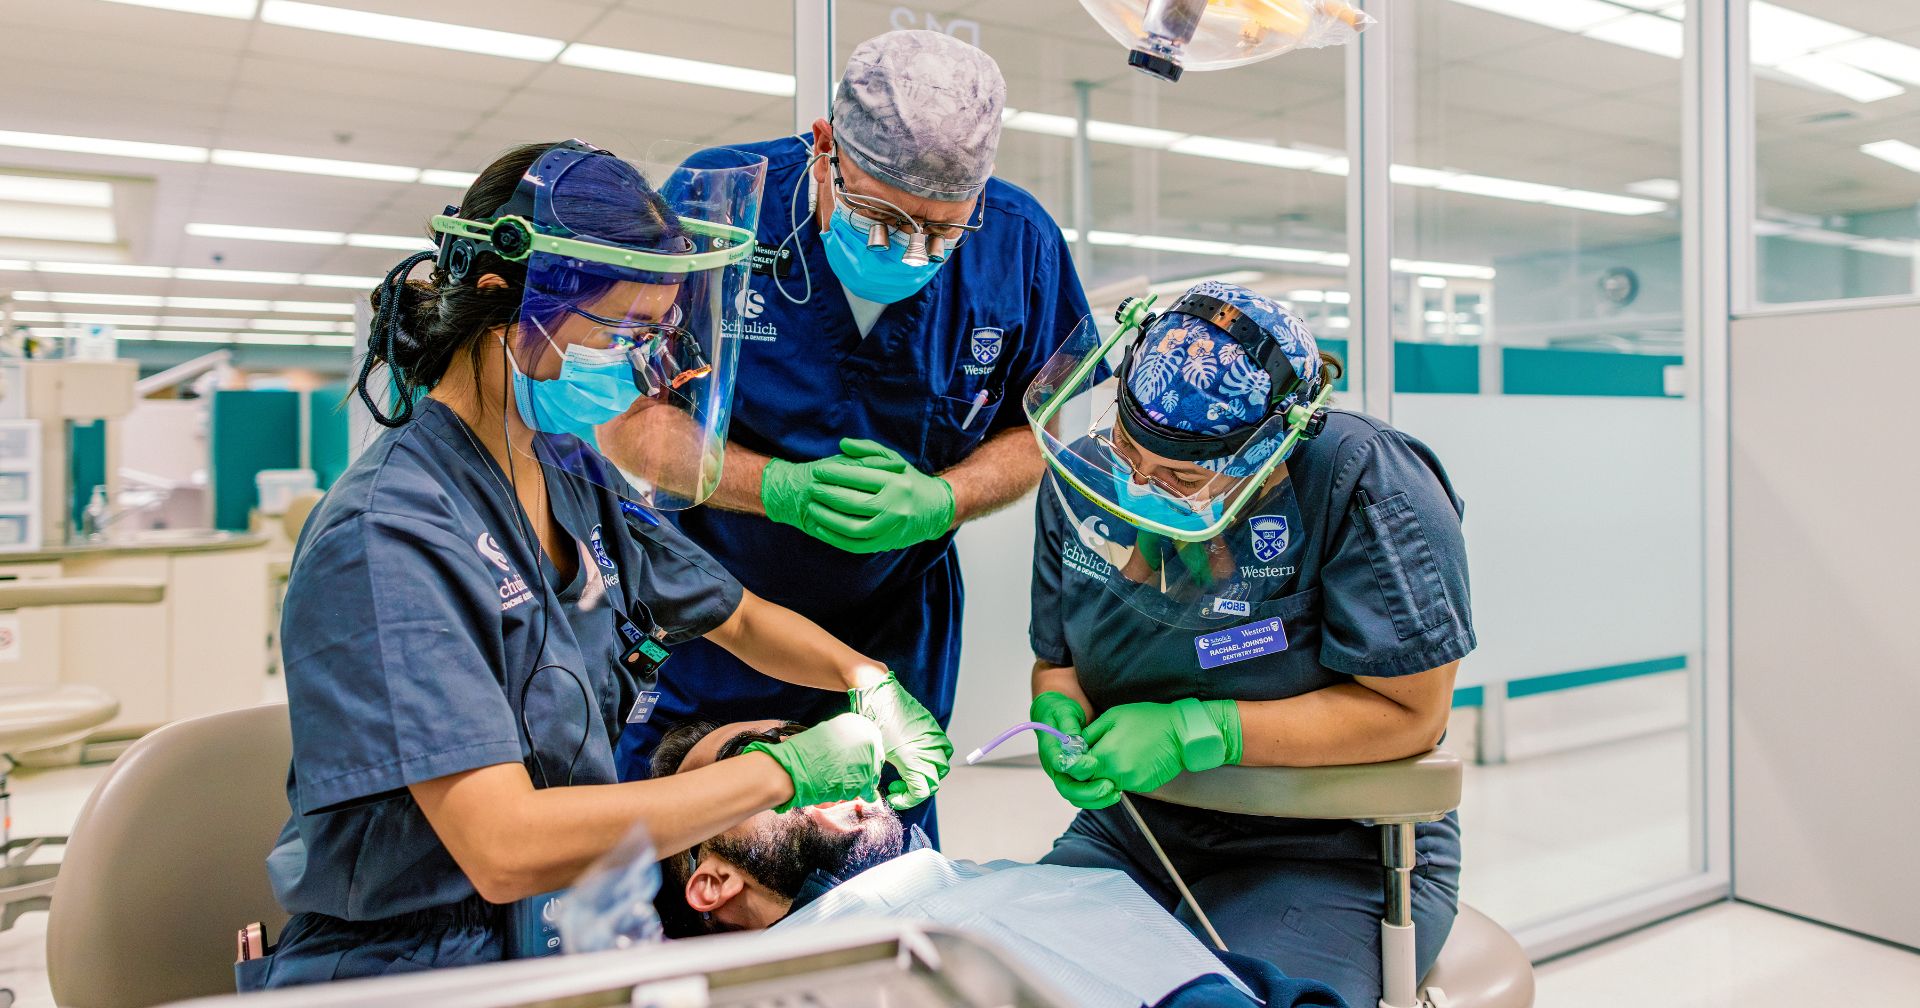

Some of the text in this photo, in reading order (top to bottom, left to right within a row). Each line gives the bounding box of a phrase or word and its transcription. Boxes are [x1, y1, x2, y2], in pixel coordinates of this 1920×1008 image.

[1062, 541, 1112, 576] Schulich
[1240, 565, 1295, 578] Western
[1218, 600, 1247, 612] MOBB
[1240, 625, 1271, 637] Western
[1209, 643, 1241, 656] RACHAEL
[1241, 635, 1274, 649] JOHNSON
[1222, 649, 1252, 661] DENTISTRY
